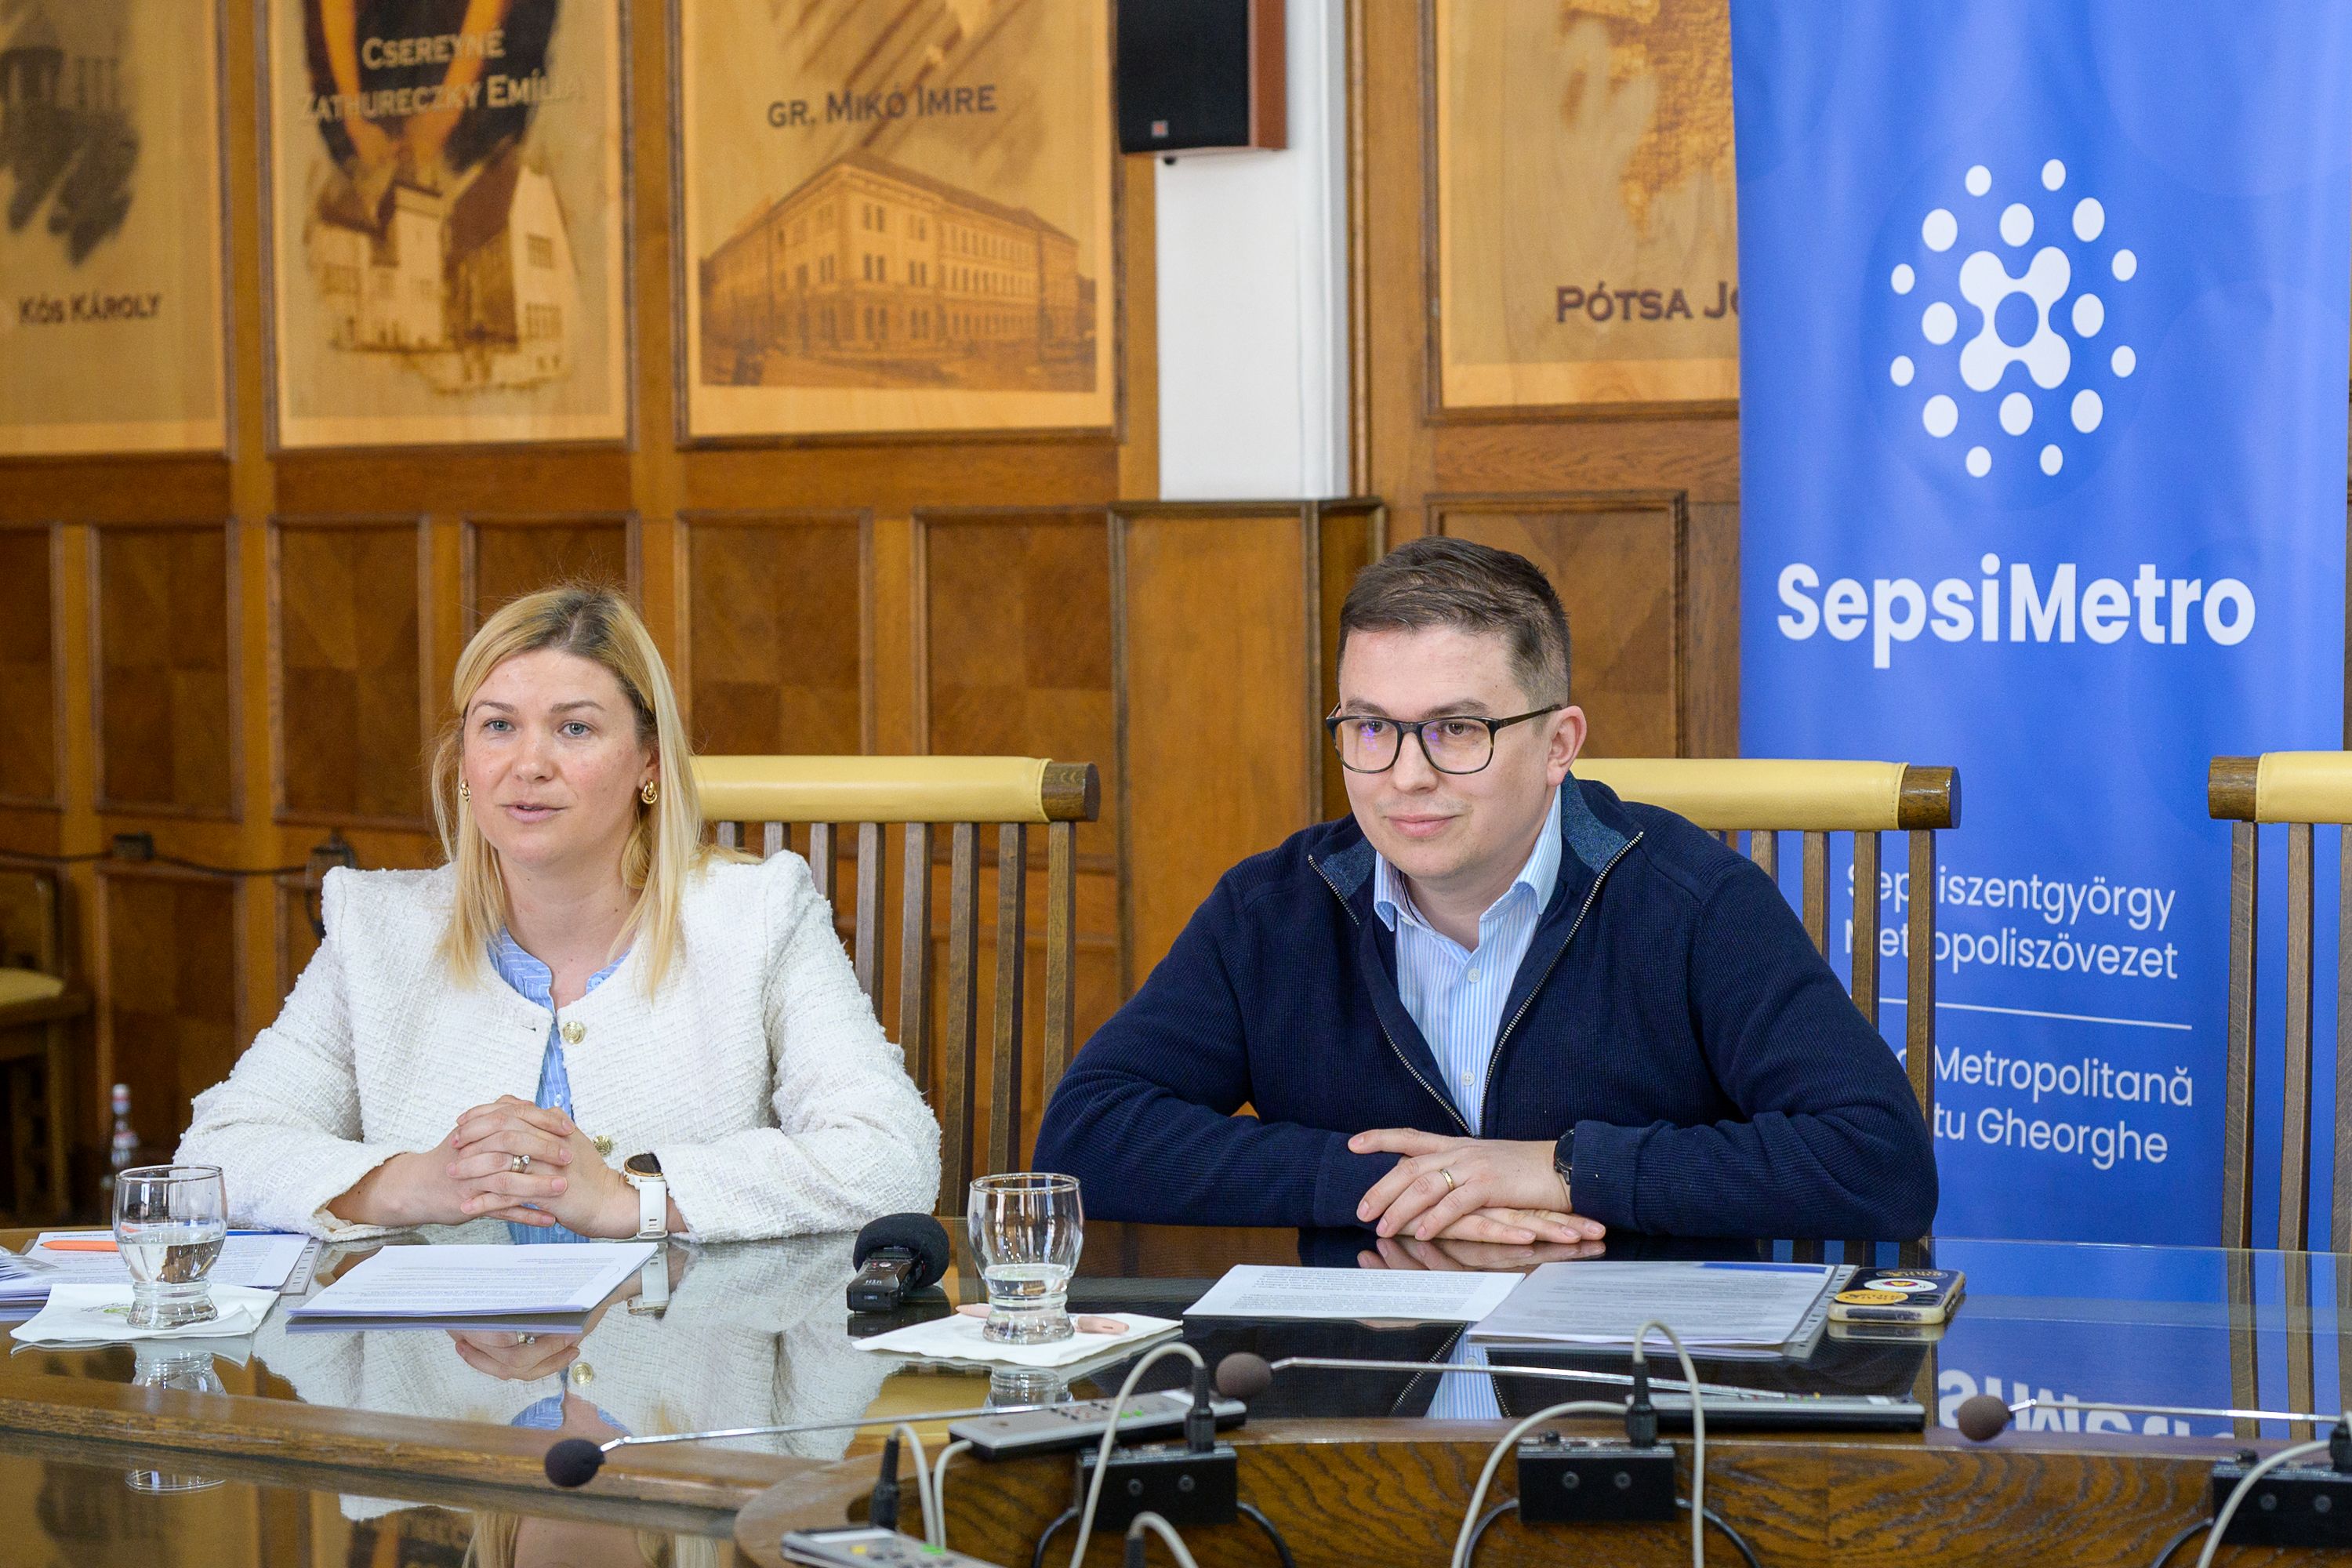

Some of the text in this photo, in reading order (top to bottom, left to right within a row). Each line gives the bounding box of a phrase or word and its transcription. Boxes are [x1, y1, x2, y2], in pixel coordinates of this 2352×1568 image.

[361, 25, 507, 71] CSEREYNÉ
[767, 82, 997, 128] GR. MIKÓ IMRE
[71, 289, 162, 322] KÁROLY
[1555, 280, 1694, 324] PÓTSA
[1777, 552, 2256, 670] SepsiMetro
[1847, 862, 2176, 931] episzentgyörgy
[1844, 918, 2179, 980] etopoliszövezet
[1934, 1044, 2194, 1108] Metropolitană
[1976, 1106, 2169, 1171] Gheorghe
